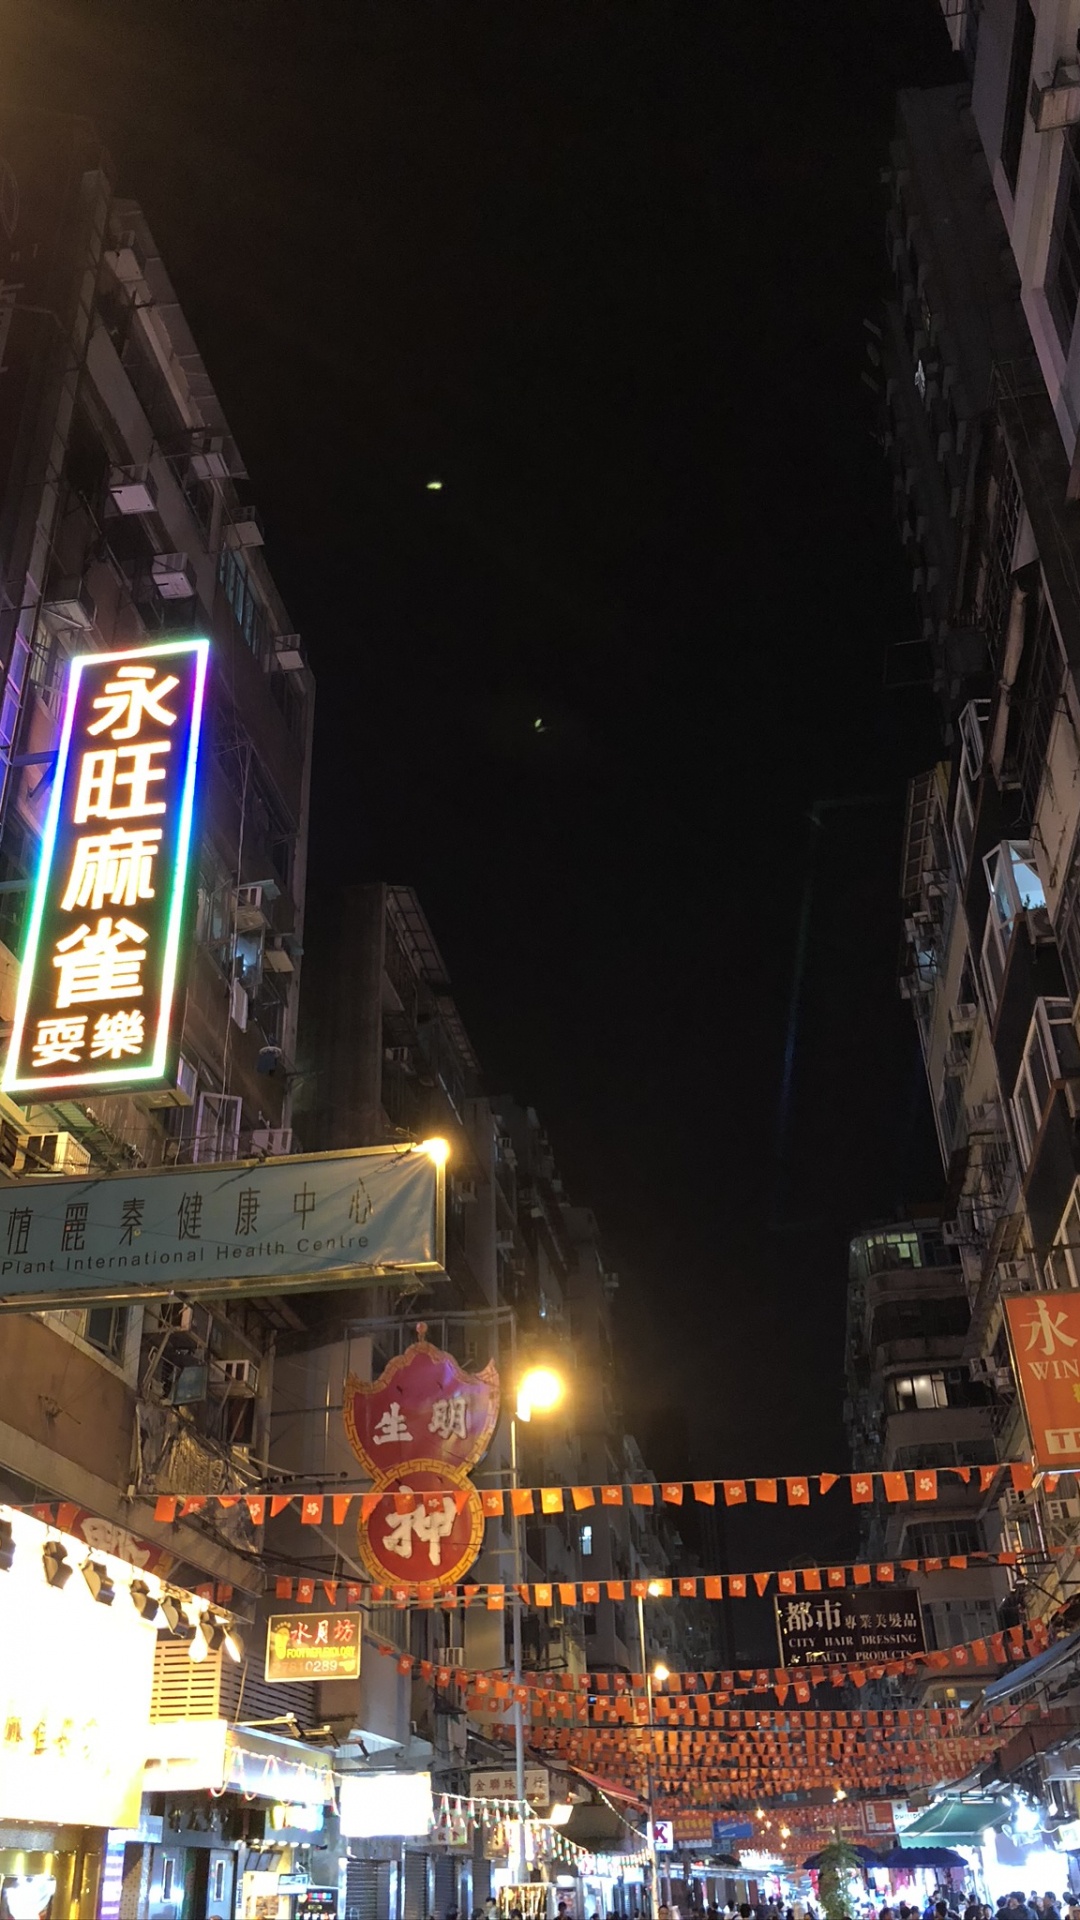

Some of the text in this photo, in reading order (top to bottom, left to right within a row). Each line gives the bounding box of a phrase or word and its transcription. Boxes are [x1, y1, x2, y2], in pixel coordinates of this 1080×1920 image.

[53, 666, 180, 1009] 永旺麻雀
[32, 1010, 145, 1067] 耍樂
[2, 1235, 369, 1275] Plant International Health Centre
[785, 1600, 842, 1632] 都市
[788, 1633, 917, 1648] CITY HAIR DRESSING
[806, 1651, 848, 1663] BEAUTY
